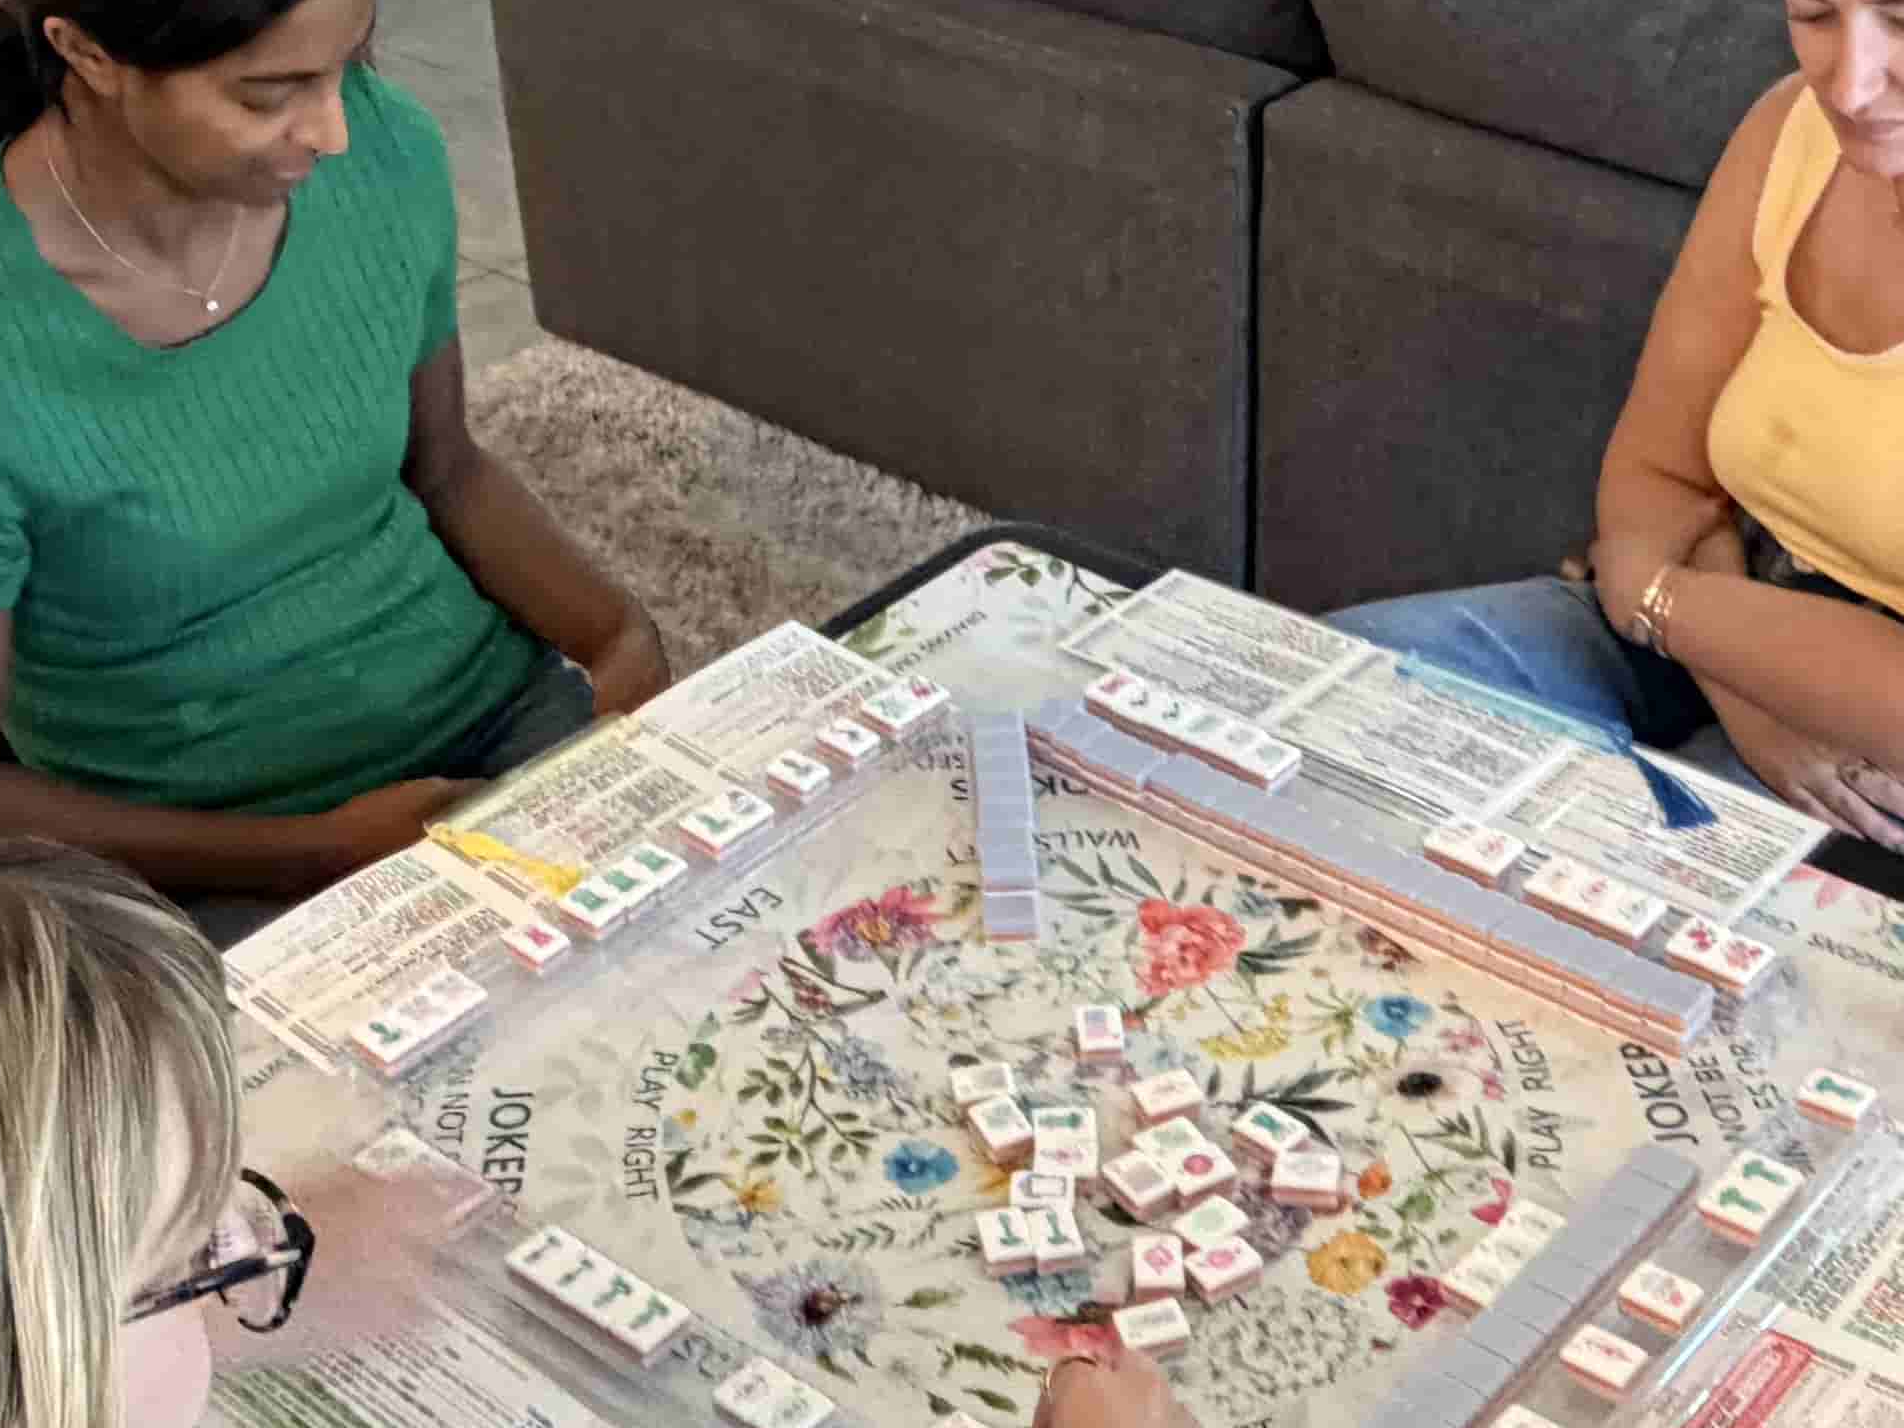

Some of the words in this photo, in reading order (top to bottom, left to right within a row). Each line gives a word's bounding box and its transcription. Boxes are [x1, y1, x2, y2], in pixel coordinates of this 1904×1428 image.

[1032, 828, 1141, 852] WALLS
[694, 887, 784, 951] EAST
[632, 1050, 679, 1114] PLAY
[1498, 1019, 1554, 1093] RIGHT
[1688, 1052, 1725, 1084] BE
[435, 1091, 471, 1144] NOT
[1527, 1105, 1562, 1171] PLAY
[1701, 1088, 1746, 1144] NOT
[622, 1125, 658, 1203] RIGHT
